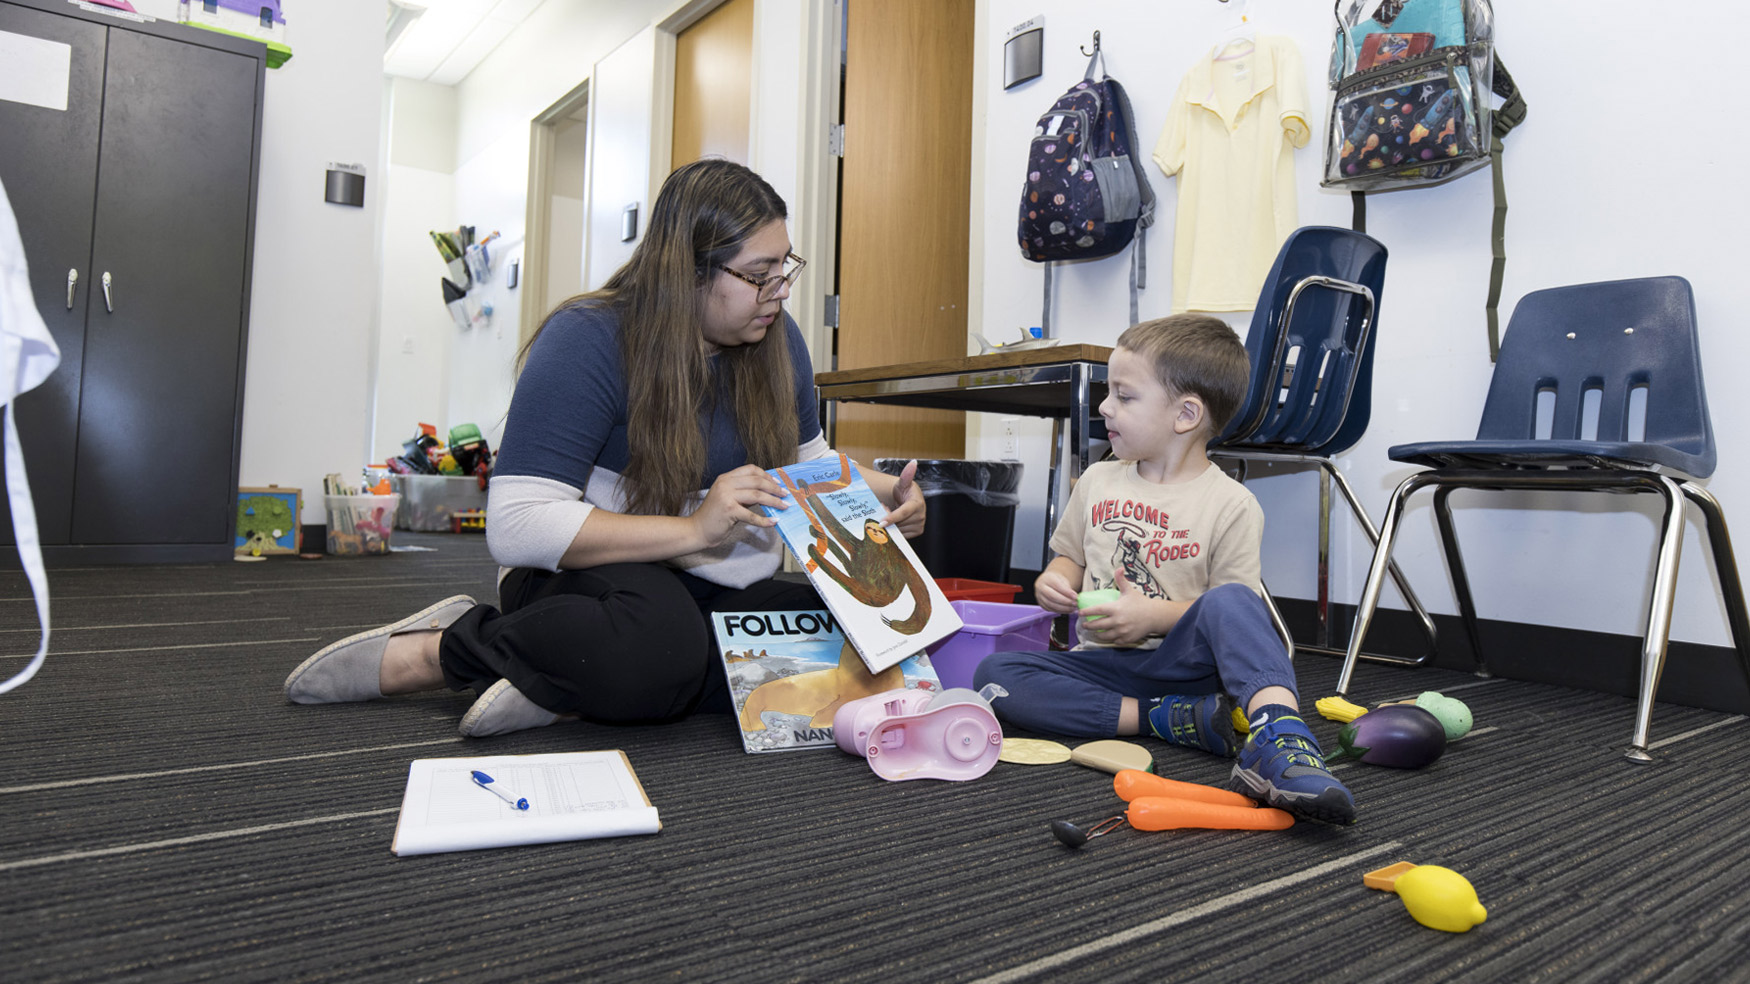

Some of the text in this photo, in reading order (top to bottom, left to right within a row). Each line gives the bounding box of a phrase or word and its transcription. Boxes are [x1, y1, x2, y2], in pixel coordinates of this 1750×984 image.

[812, 470, 841, 481] Eric Carle
[837, 497, 857, 507] Slowly,
[841, 507, 876, 523] said the Sloth
[1091, 499, 1170, 530] WELCOME
[1153, 529, 1190, 539] TO THE
[1143, 539, 1200, 569] RODEO
